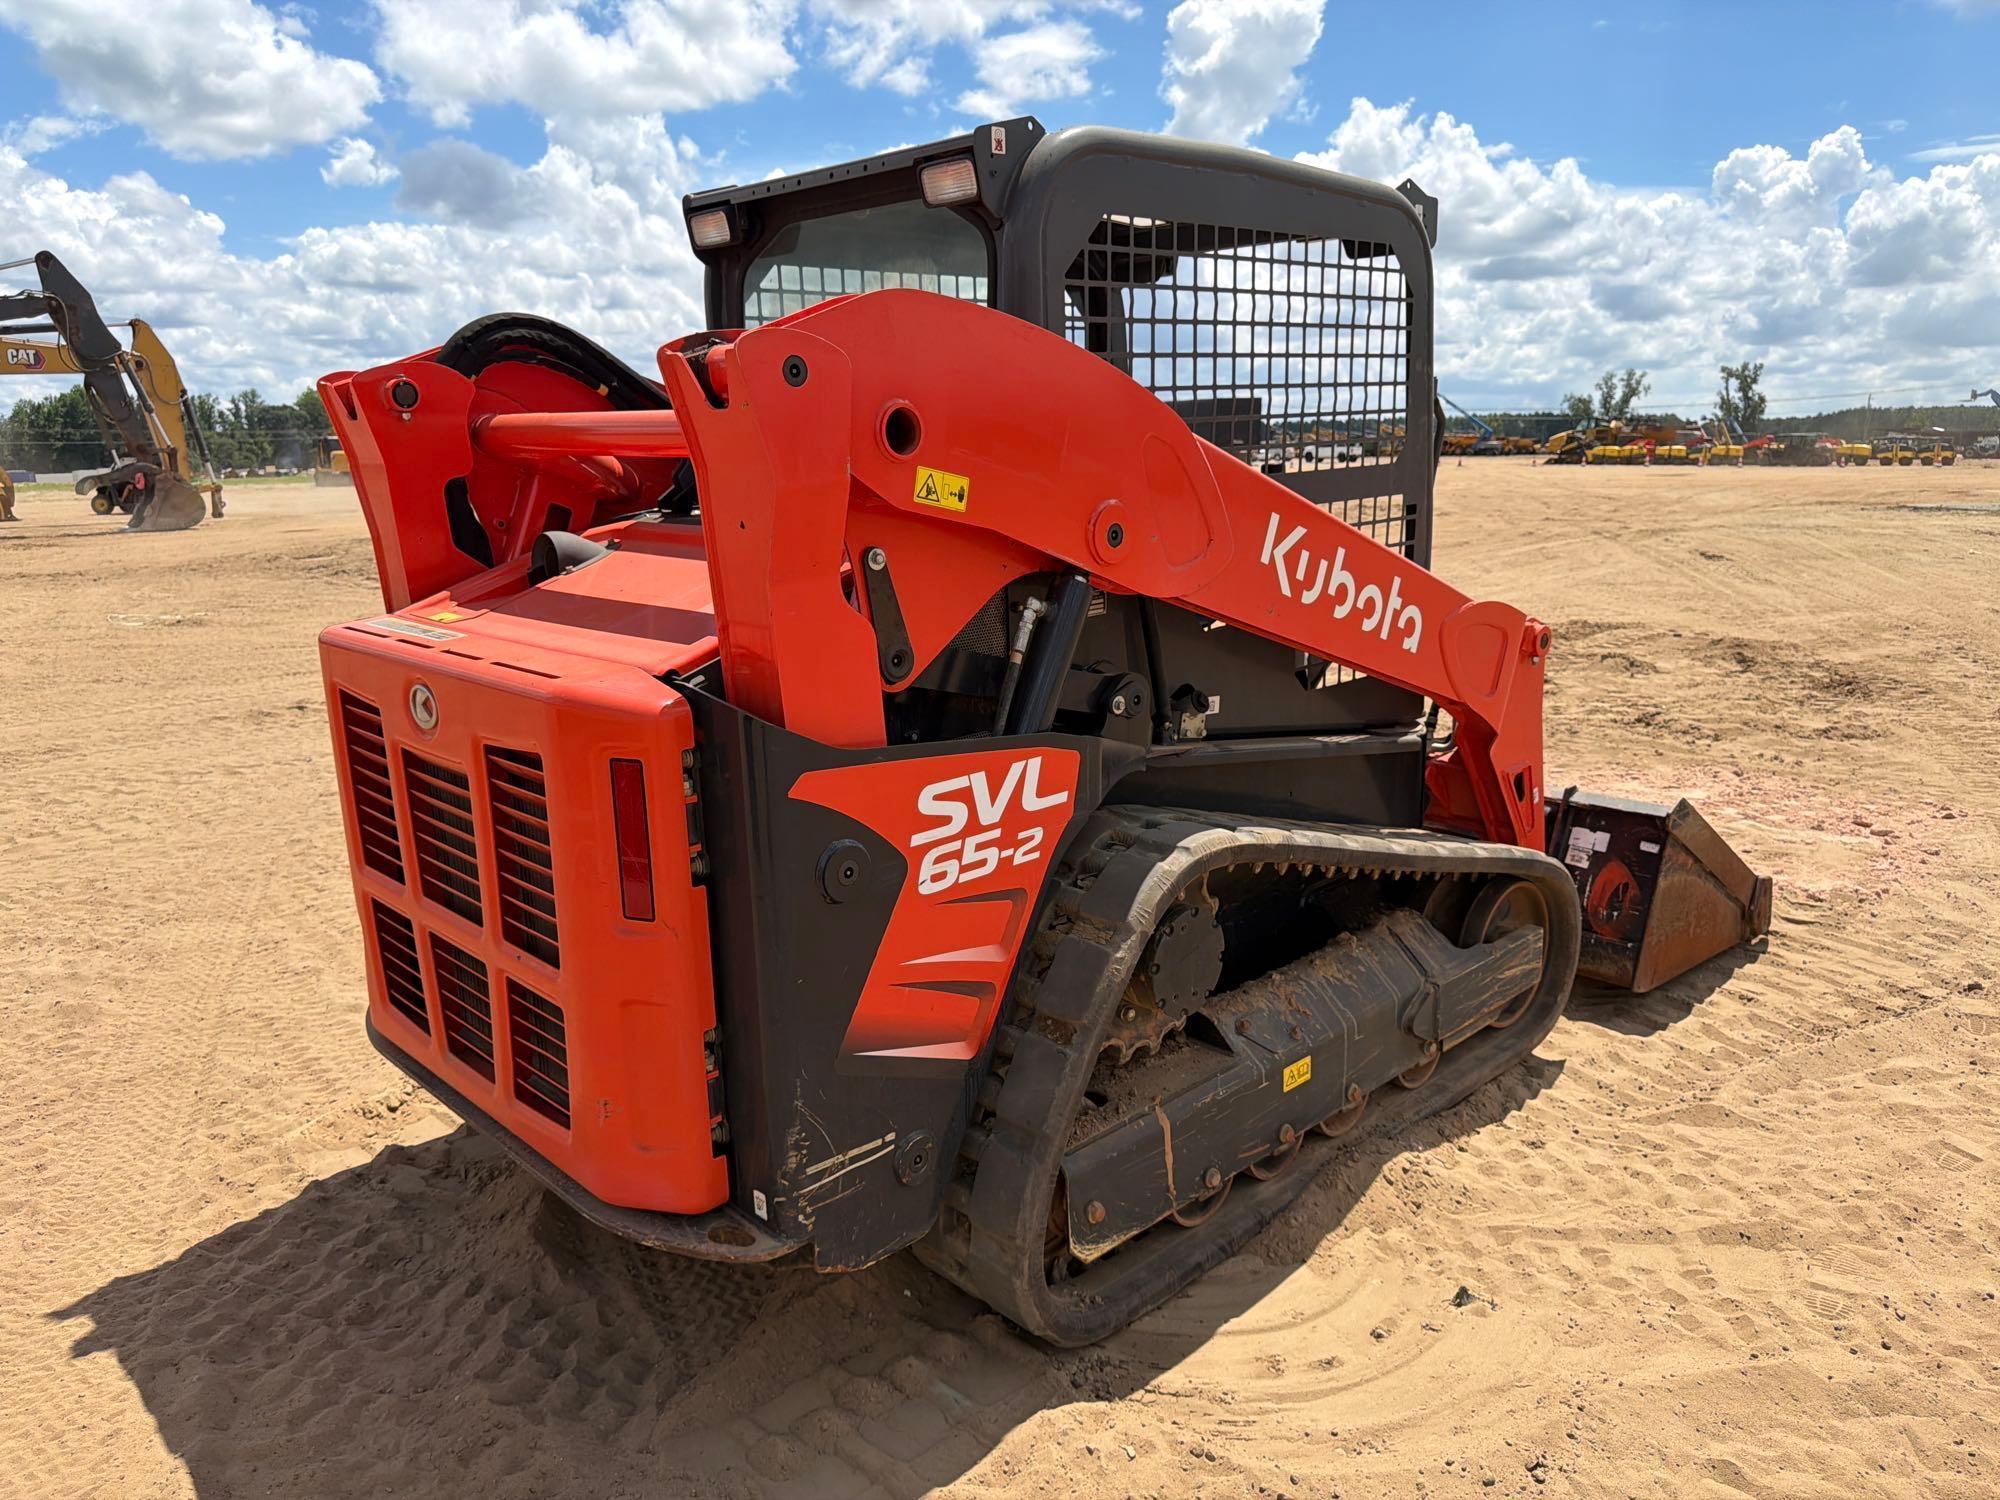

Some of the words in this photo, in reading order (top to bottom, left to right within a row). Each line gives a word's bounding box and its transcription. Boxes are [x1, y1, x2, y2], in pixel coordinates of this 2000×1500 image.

[7, 349, 36, 365] CAT
[1260, 512, 1423, 654] Kubota
[910, 756, 1069, 848] SVL
[917, 826, 1044, 895] 65-2
